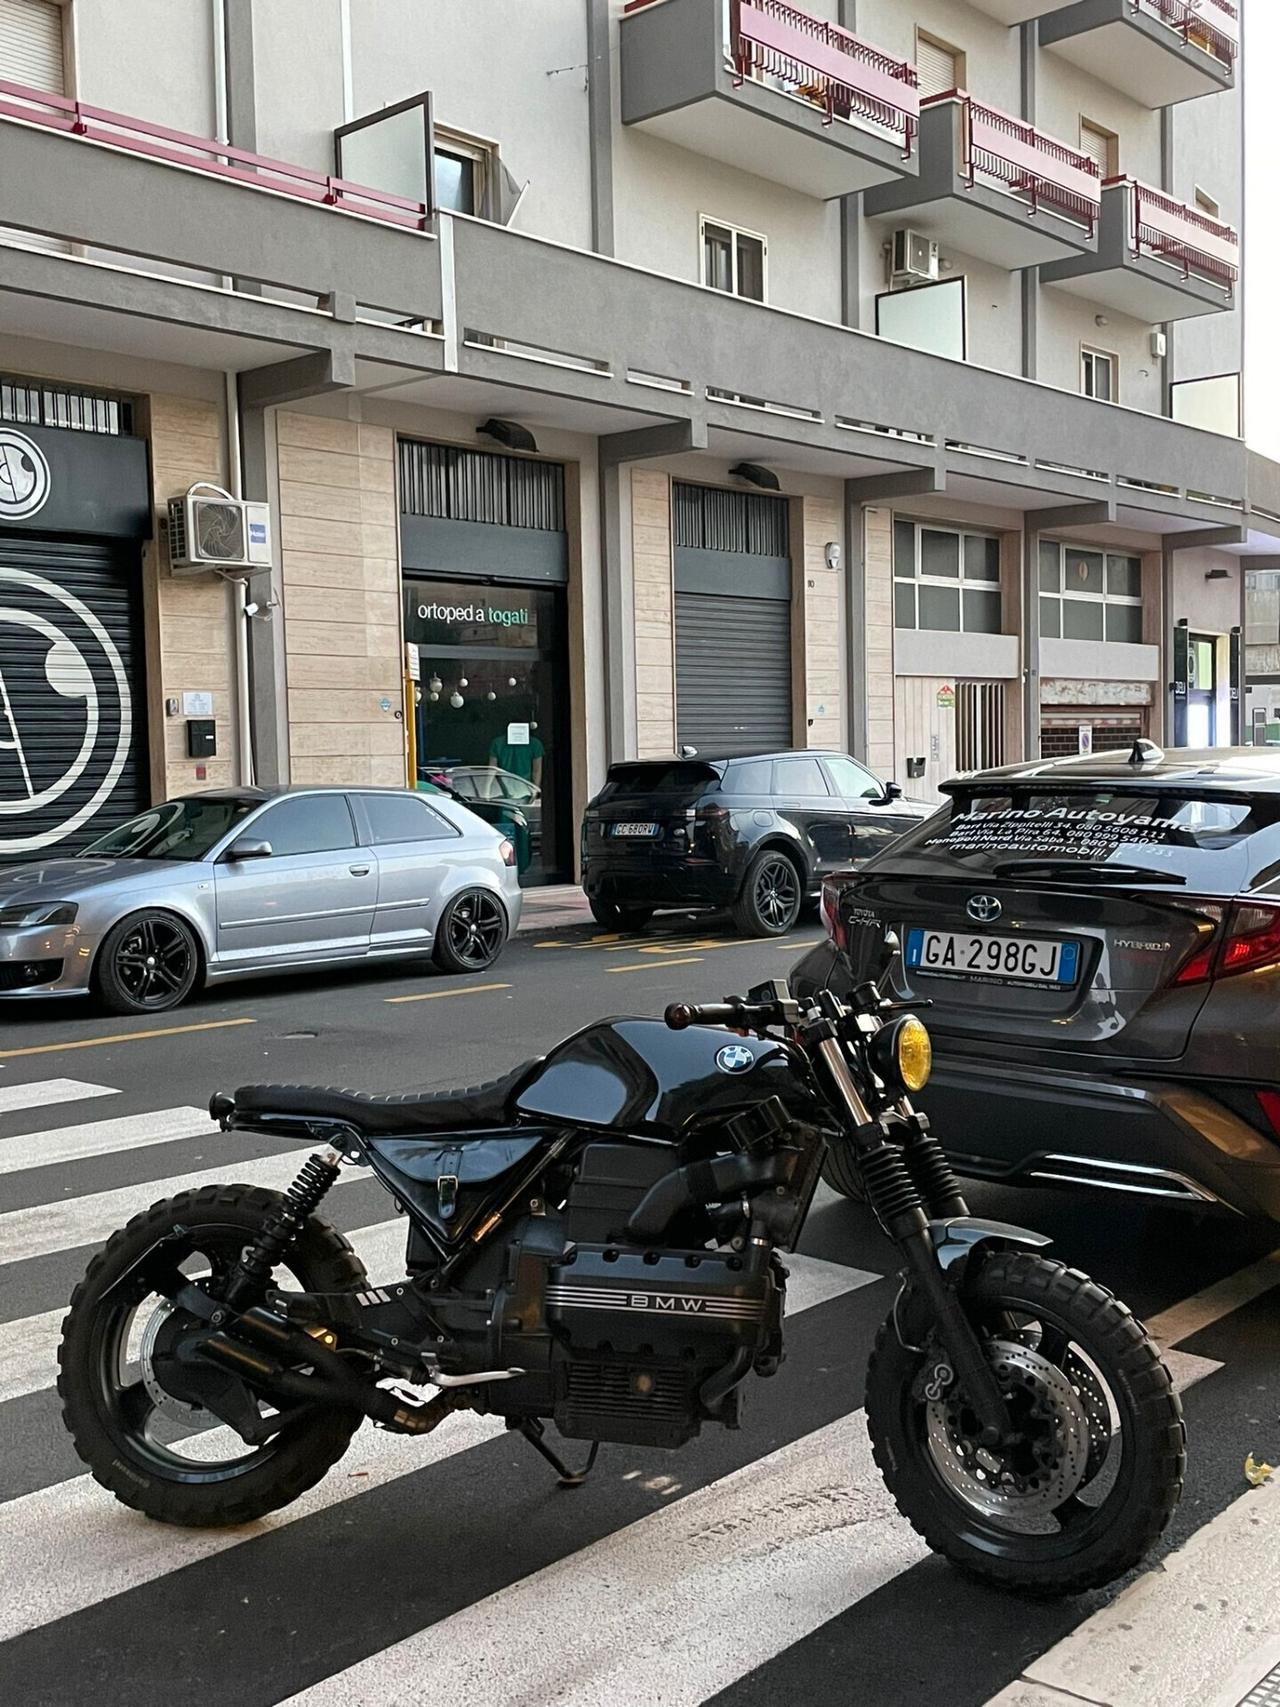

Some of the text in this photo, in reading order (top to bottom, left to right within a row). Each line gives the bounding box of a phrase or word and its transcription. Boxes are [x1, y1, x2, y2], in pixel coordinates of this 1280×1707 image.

[488, 607, 528, 627] togati
[950, 808, 1041, 824] Marino
[1066, 830, 1093, 838] 080
[1093, 831, 1119, 841] 999
[1076, 823, 1102, 831] 080
[1103, 825, 1138, 835] 5608
[926, 935, 1057, 976] GA 298GJ
[631, 1295, 702, 1311] BMW
